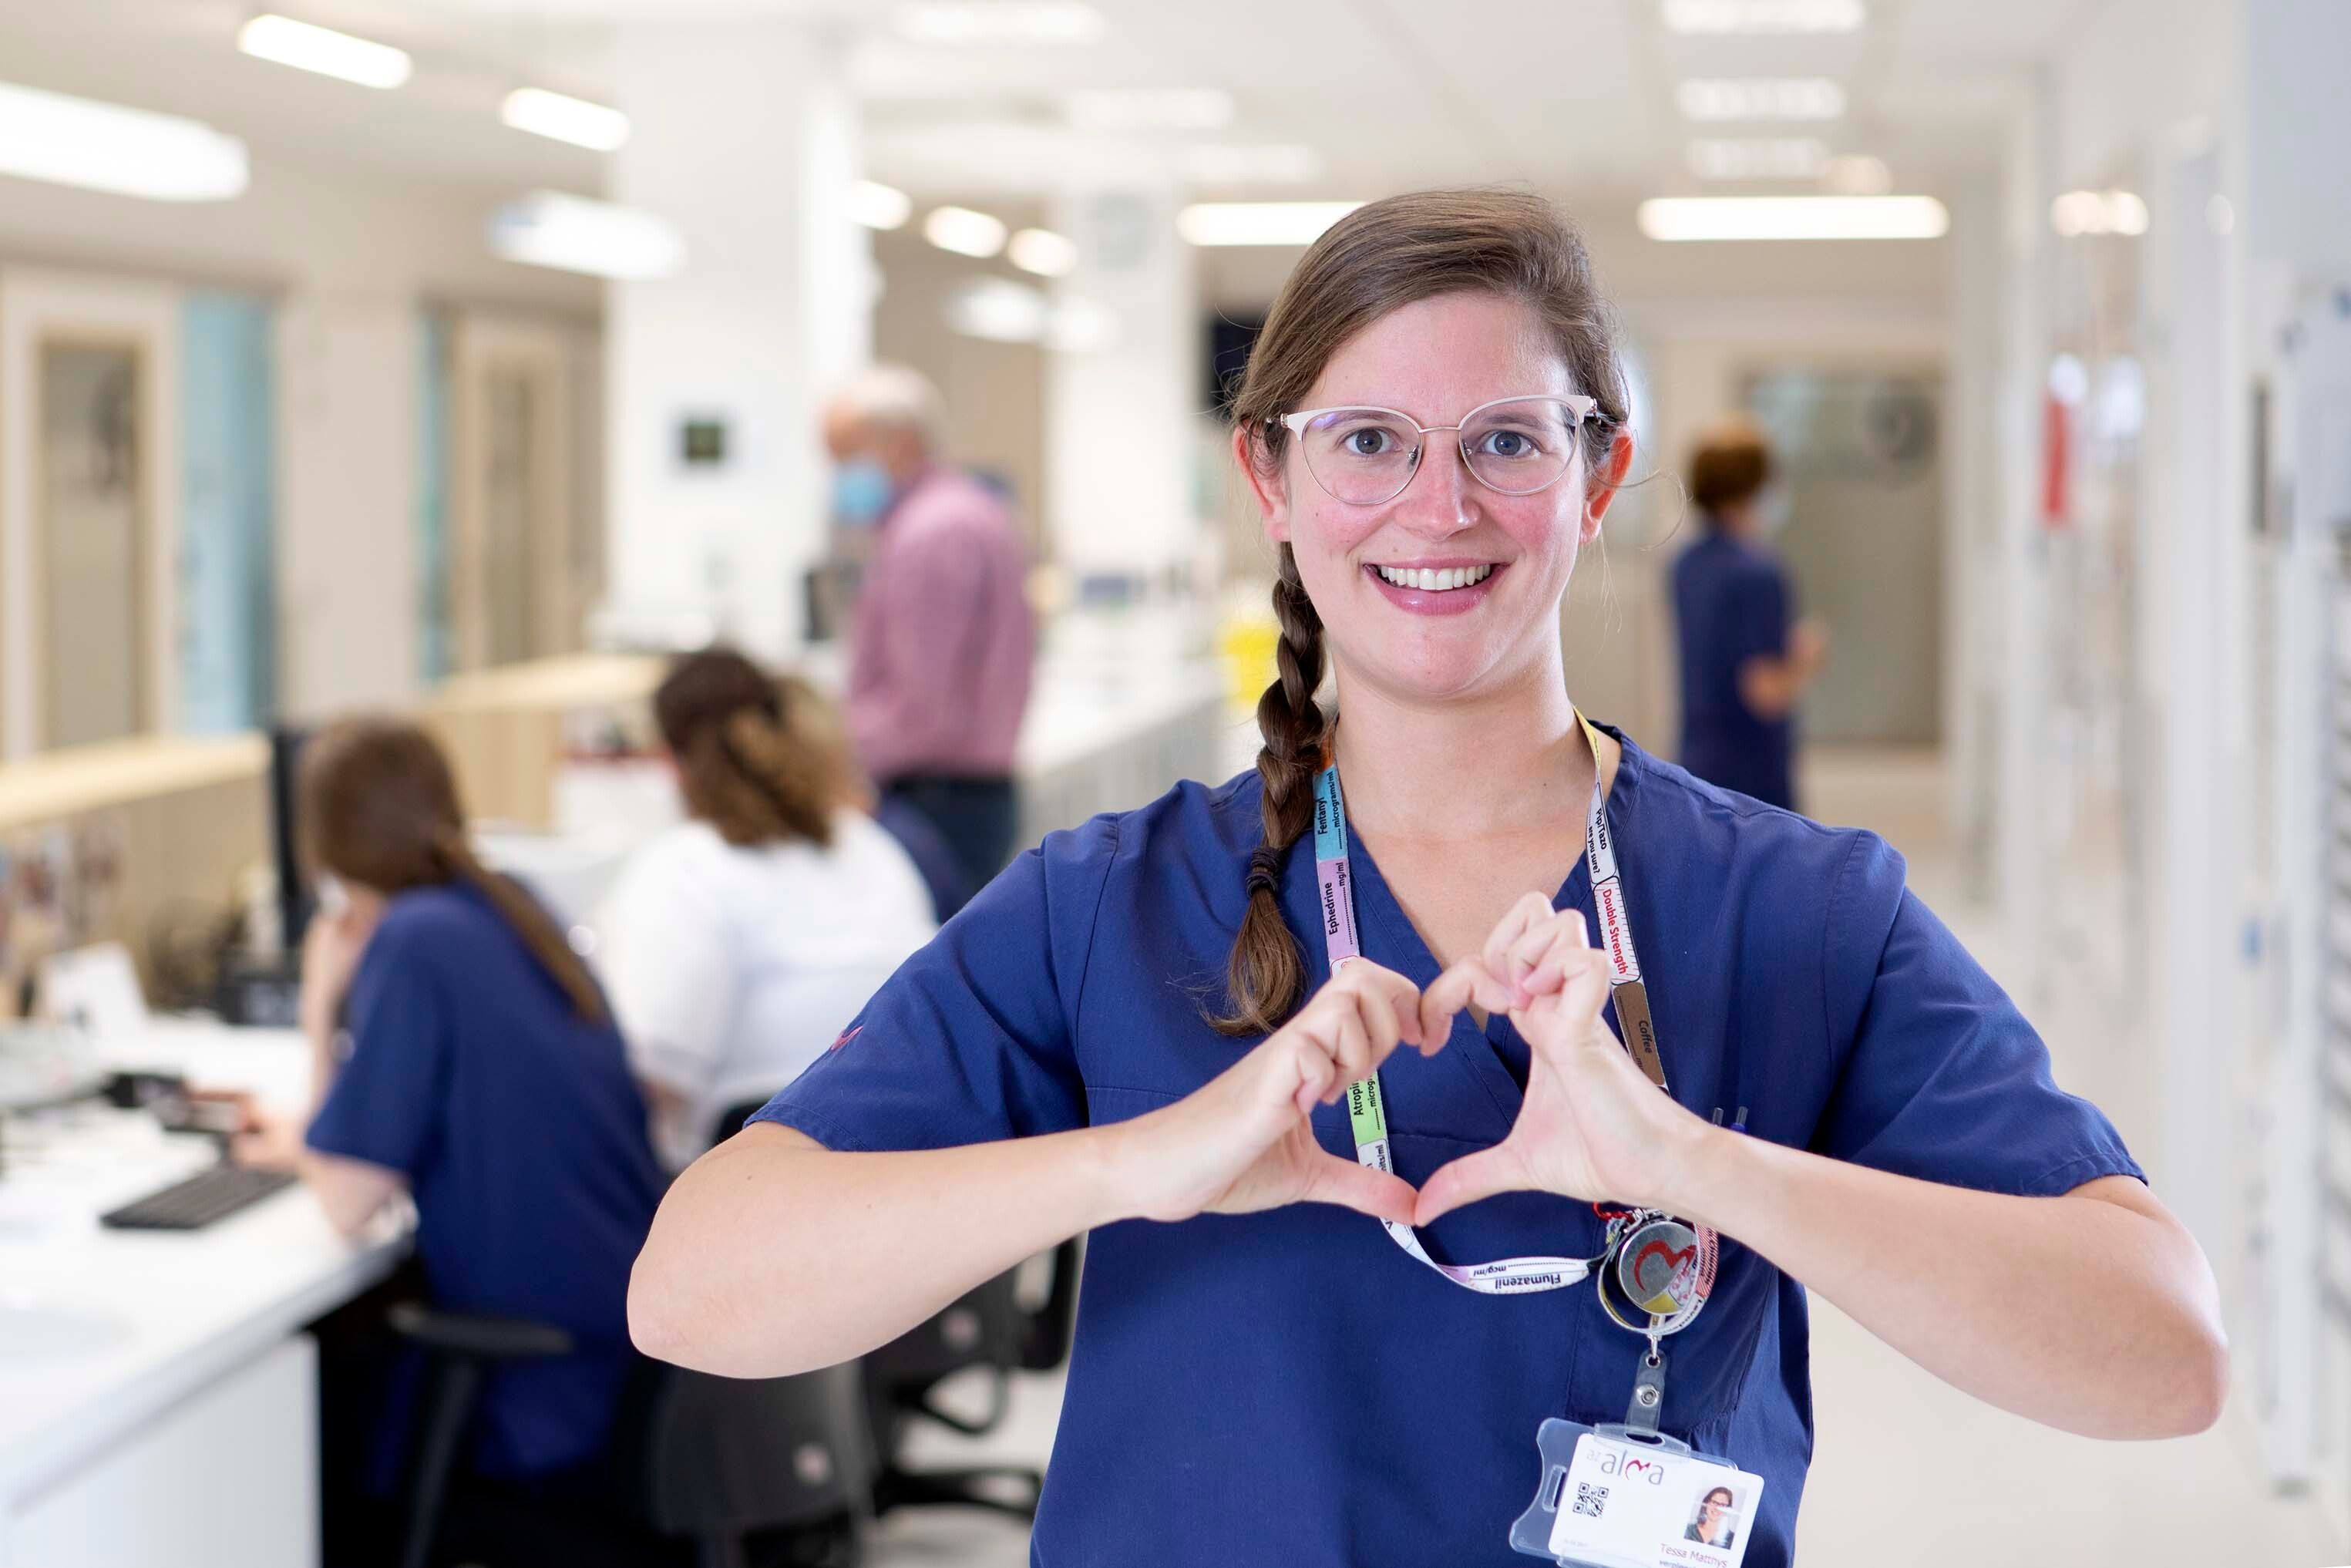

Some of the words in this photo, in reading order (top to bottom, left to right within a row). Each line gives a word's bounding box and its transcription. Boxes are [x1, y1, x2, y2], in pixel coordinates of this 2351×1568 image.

[1327, 771, 1340, 827] micrograms/ml
[1317, 797, 1328, 835] Fentanyl
[1335, 862, 1347, 887] mg/ml
[1591, 853, 1601, 874] sure?
[1324, 882, 1340, 935] Ephedrine
[1603, 888, 1616, 927] Double
[1609, 927, 1629, 974] Strength
[1639, 1020, 1653, 1053] Coffee
[1473, 1264, 1507, 1277] mcg/ml
[1495, 1274, 1561, 1290] Flumazenil
[1660, 1543, 1687, 1558] Tessa
